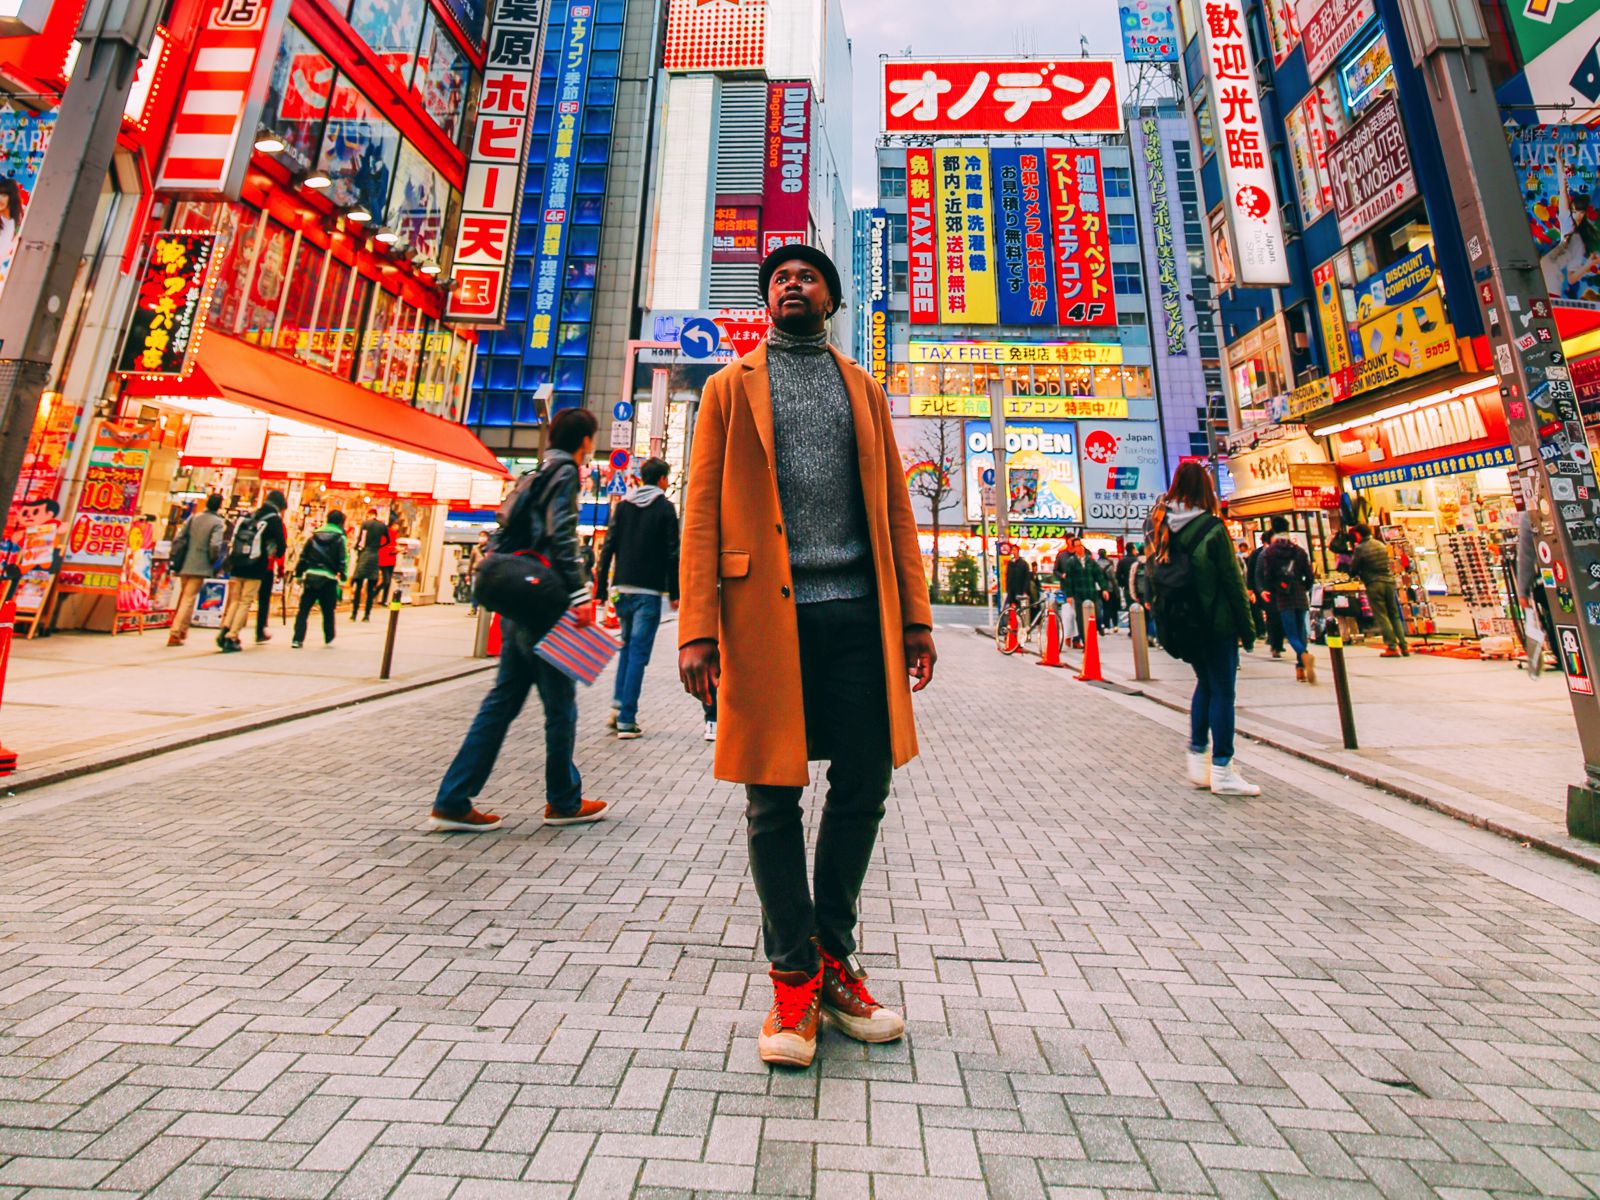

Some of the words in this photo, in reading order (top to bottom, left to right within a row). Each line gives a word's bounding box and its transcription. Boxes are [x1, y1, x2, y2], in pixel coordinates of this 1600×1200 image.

[1325, 19, 1358, 64] TAKARADA
[888, 61, 1112, 123] オノデン
[769, 87, 784, 134] Flagship
[780, 87, 810, 139] Duty
[769, 136, 782, 169] Store
[1342, 128, 1373, 158] English
[1347, 122, 1404, 183] COMPUTER
[780, 142, 808, 194] Free
[909, 155, 931, 199] 免税
[1361, 147, 1409, 200] MOBILE
[449, 73, 528, 317] ホビー天国
[1358, 190, 1396, 226] TAKARADA
[910, 202, 932, 247] TAX
[1000, 165, 1025, 294] お見積り無料です
[871, 216, 887, 301] Panasonic
[1385, 252, 1424, 284] DISCOUNT
[911, 251, 935, 314] FREE
[1384, 264, 1433, 299] COMPUTERS
[731, 330, 761, 342] 止まれ
[872, 310, 887, 385] ONODEN
[919, 347, 954, 361] TAX
[958, 347, 1005, 361] FREE
[1009, 347, 1051, 362] 免税店
[1351, 351, 1390, 377] DISCOUNT
[1365, 365, 1400, 391] MOBILES
[1550, 390, 1574, 400] ONE
[1551, 381, 1569, 392] JS
[920, 400, 957, 413] テレビ
[1008, 401, 1061, 414] エアコン
[968, 431, 1073, 455] OODEN
[1382, 396, 1489, 458] TAKARADA
[1559, 461, 1578, 470] SKATE
[1089, 503, 1152, 520] ONODE
